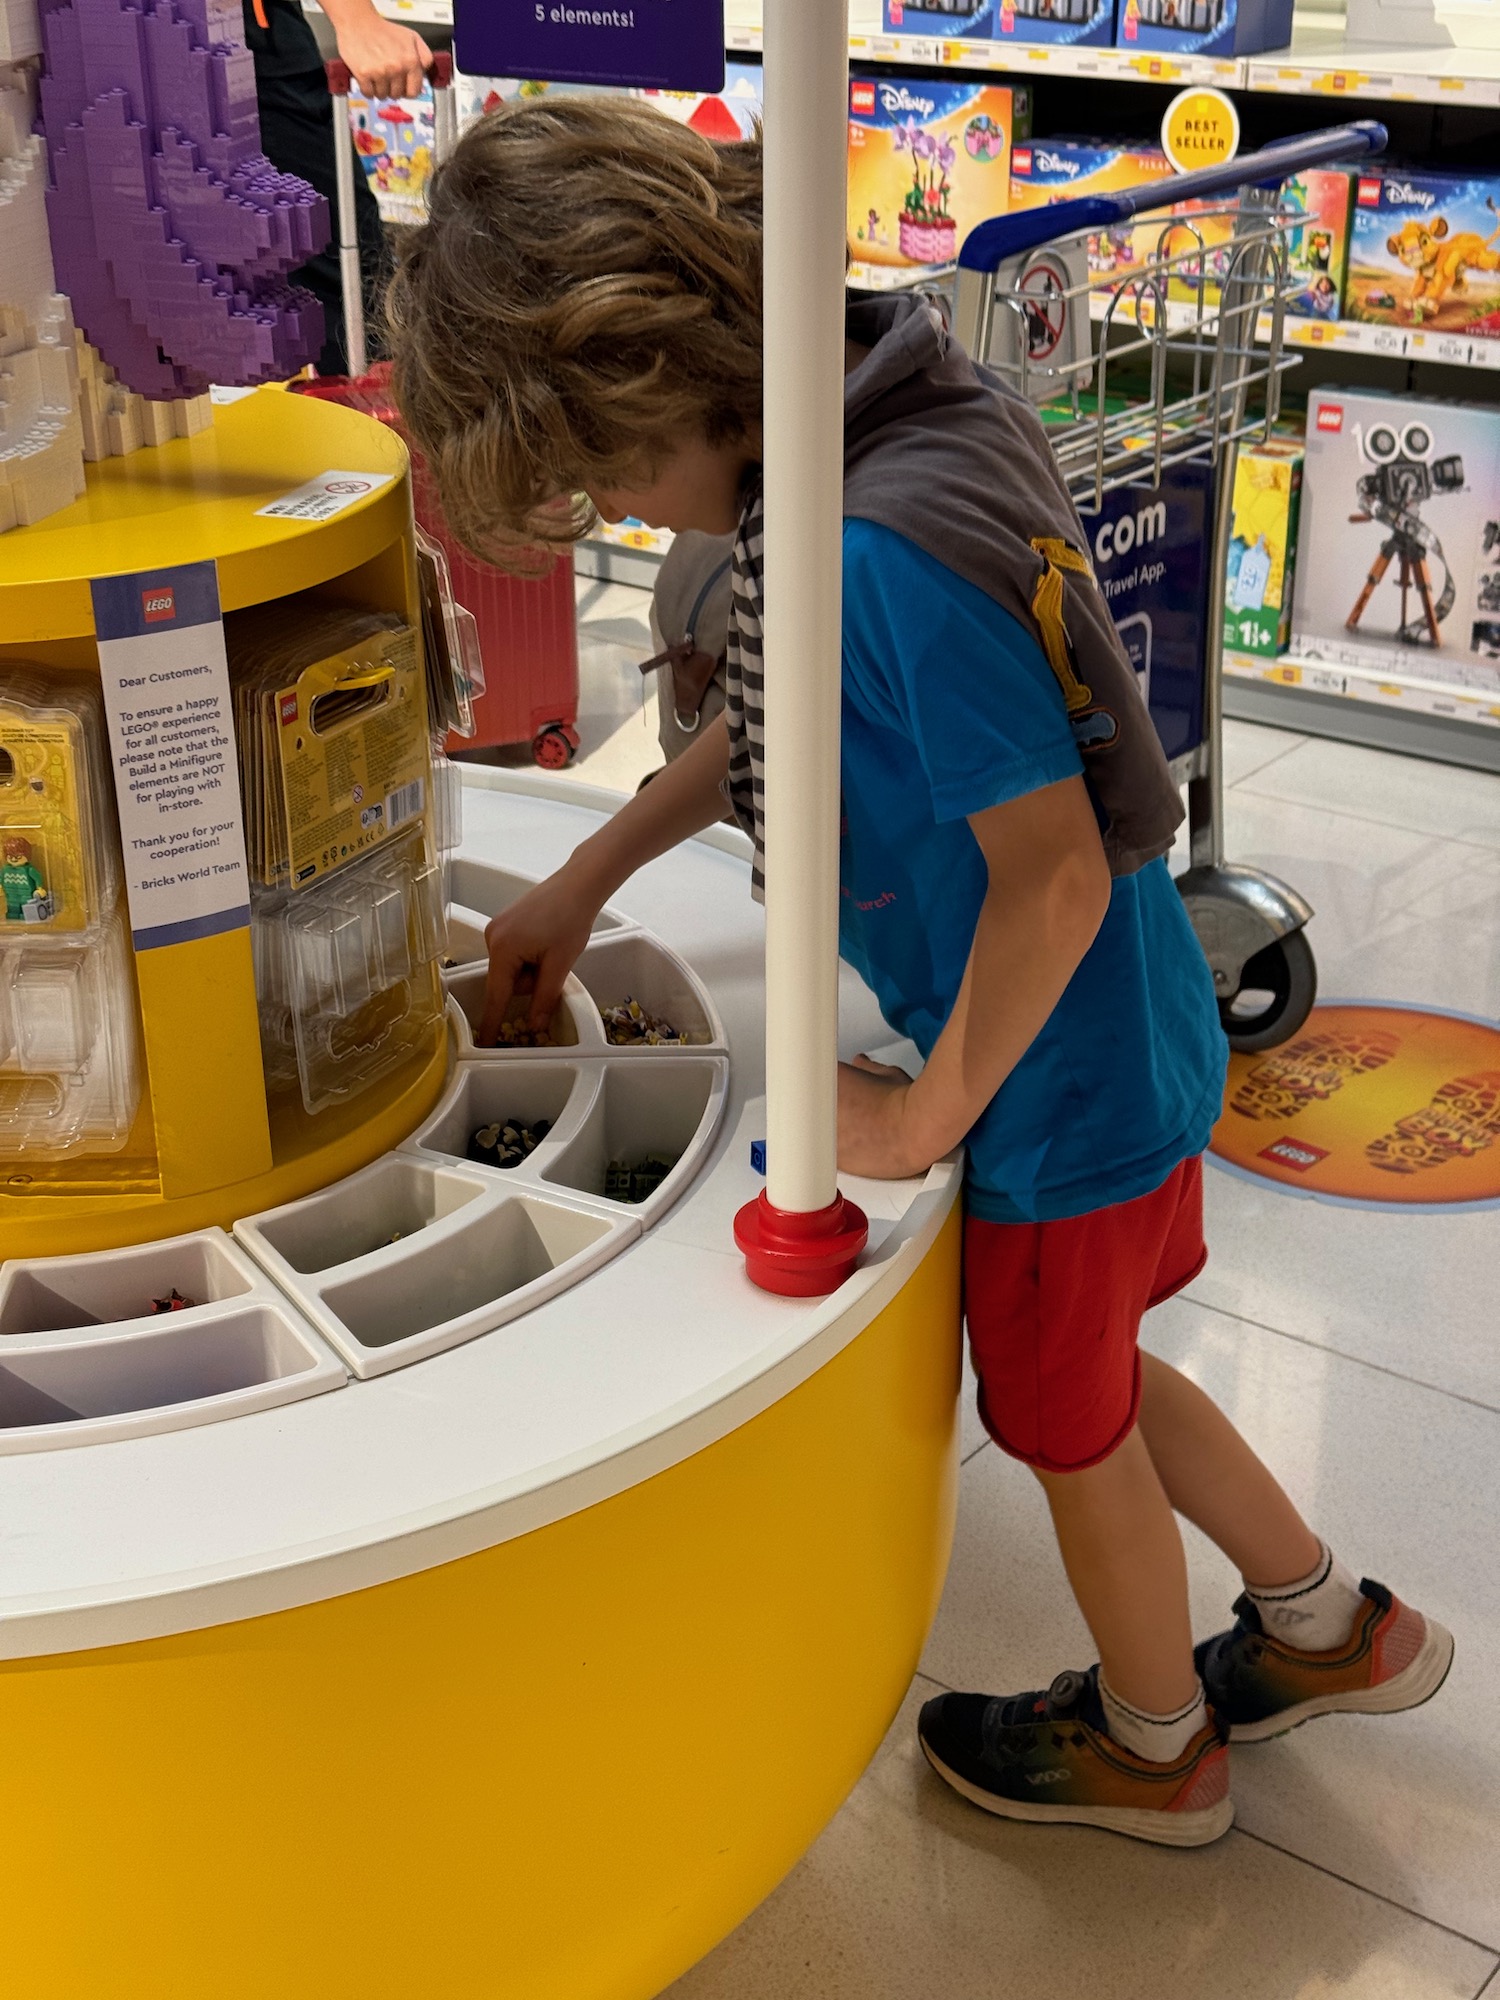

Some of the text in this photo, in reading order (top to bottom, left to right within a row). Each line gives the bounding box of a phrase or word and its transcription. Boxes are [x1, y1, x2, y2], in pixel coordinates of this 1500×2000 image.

[535, 4, 635, 27] 5 elements!
[878, 82, 935, 119] Disney
[1184, 119, 1219, 132] BEST
[1175, 137, 1225, 150] SELLER
[1034, 149, 1080, 178] Disney
[1384, 179, 1436, 211] Disney
[1103, 561, 1167, 599] Travel App.
[145, 597, 173, 612] LEGO
[119, 665, 213, 688] Dear Customers,
[119, 697, 219, 722] To ensure a happy
[162, 710, 221, 728] experience
[126, 725, 220, 750] for all customers,
[119, 736, 229, 767] please note that the
[128, 763, 226, 791] elements are NOT
[129, 752, 223, 777] Build a Minifigure
[136, 778, 222, 804] for playing with
[158, 798, 204, 813] in-store.
[131, 820, 235, 850] Thank you for your
[150, 836, 221, 860] cooperation!
[141, 875, 176, 890] Bricks
[177, 867, 211, 882] World
[212, 861, 241, 875] Team
